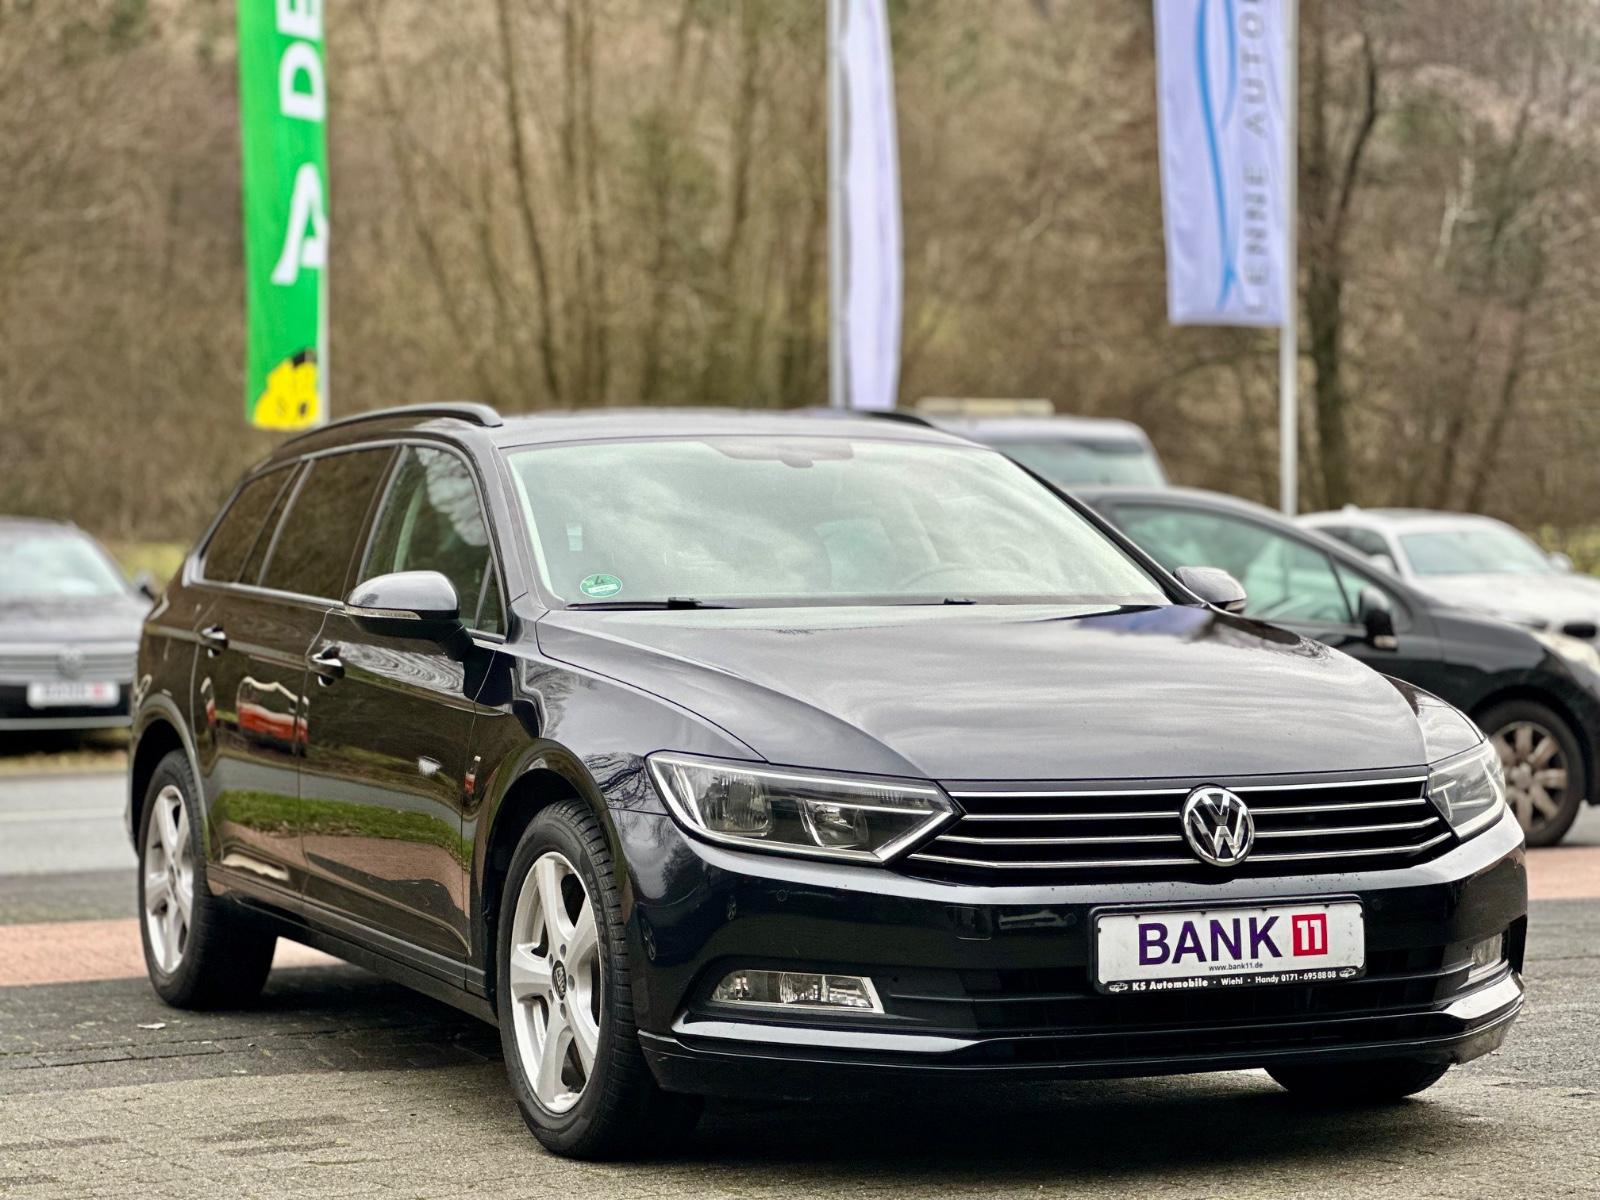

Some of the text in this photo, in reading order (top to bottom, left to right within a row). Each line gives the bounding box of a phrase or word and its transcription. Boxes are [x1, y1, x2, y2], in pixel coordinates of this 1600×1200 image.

[1138, 916, 1323, 966] BANK 11
[1208, 962, 1264, 972] www.bank11.de
[1132, 981, 1147, 991] KS
[1149, 978, 1208, 991] Automobile
[1221, 976, 1243, 986] Wiehl
[1255, 975, 1279, 985] Handy
